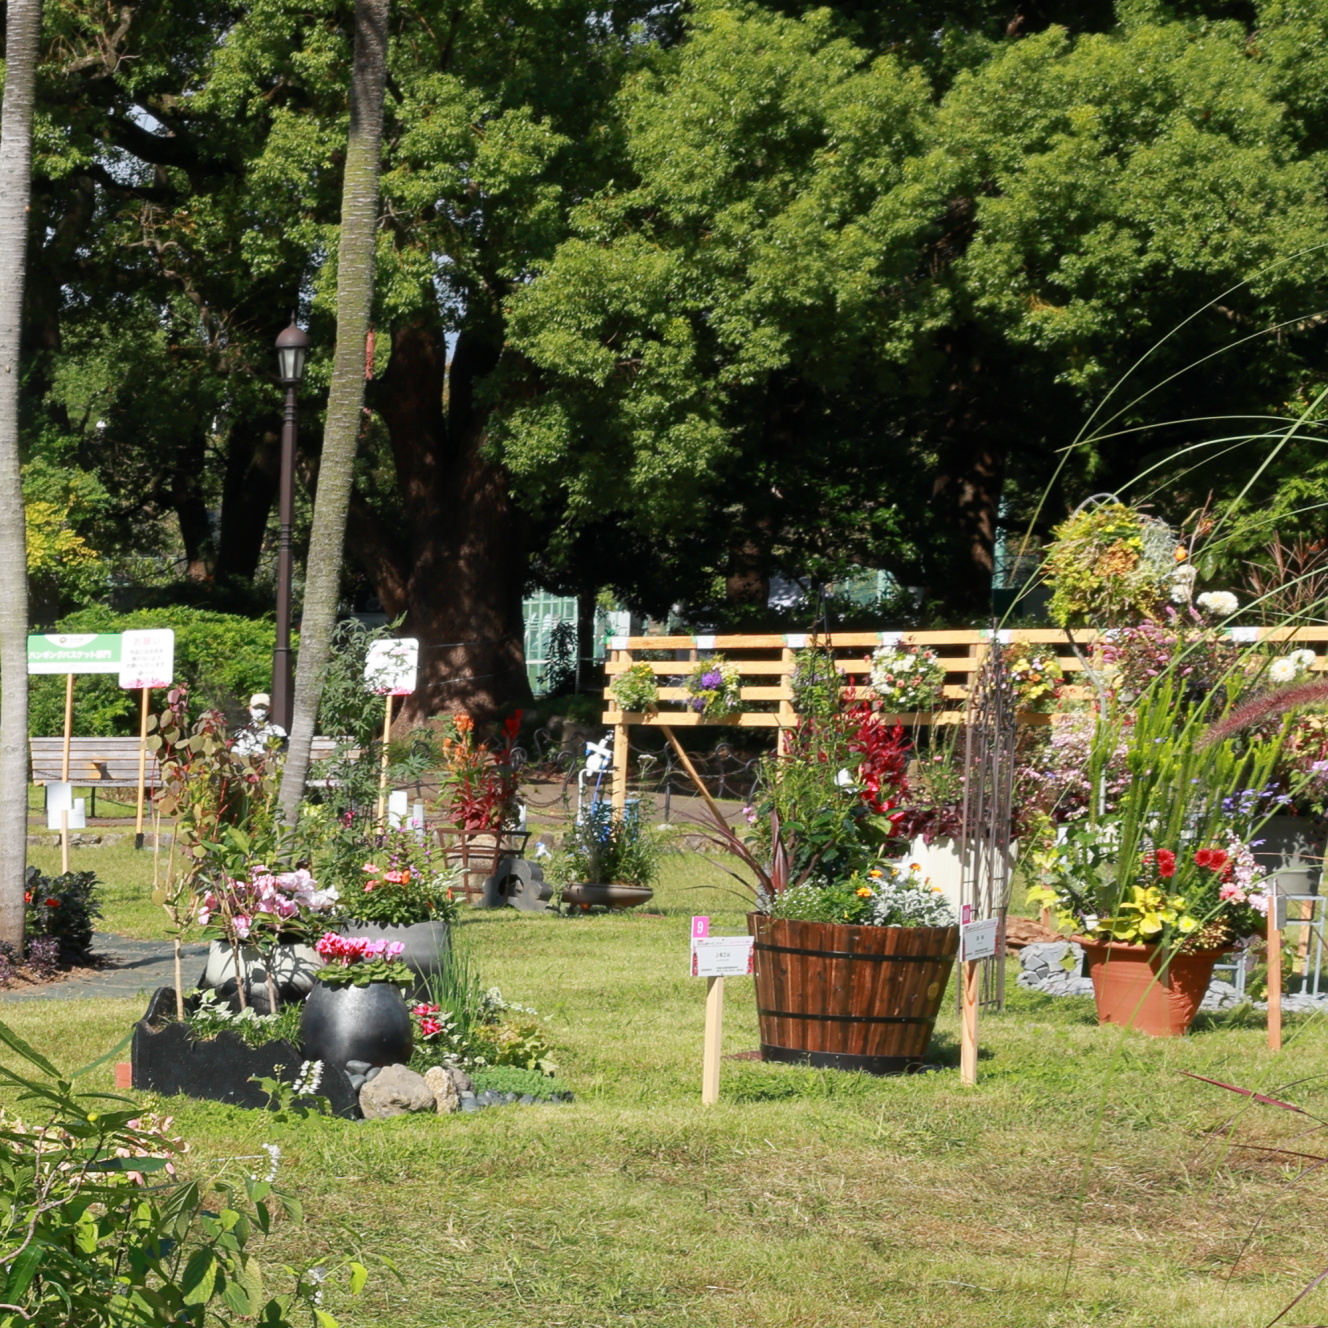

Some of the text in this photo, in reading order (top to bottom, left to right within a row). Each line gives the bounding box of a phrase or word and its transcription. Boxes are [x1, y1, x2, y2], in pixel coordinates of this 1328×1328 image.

[28, 649, 112, 660] ハンギングバスケット部門
[696, 920, 704, 934] 9
